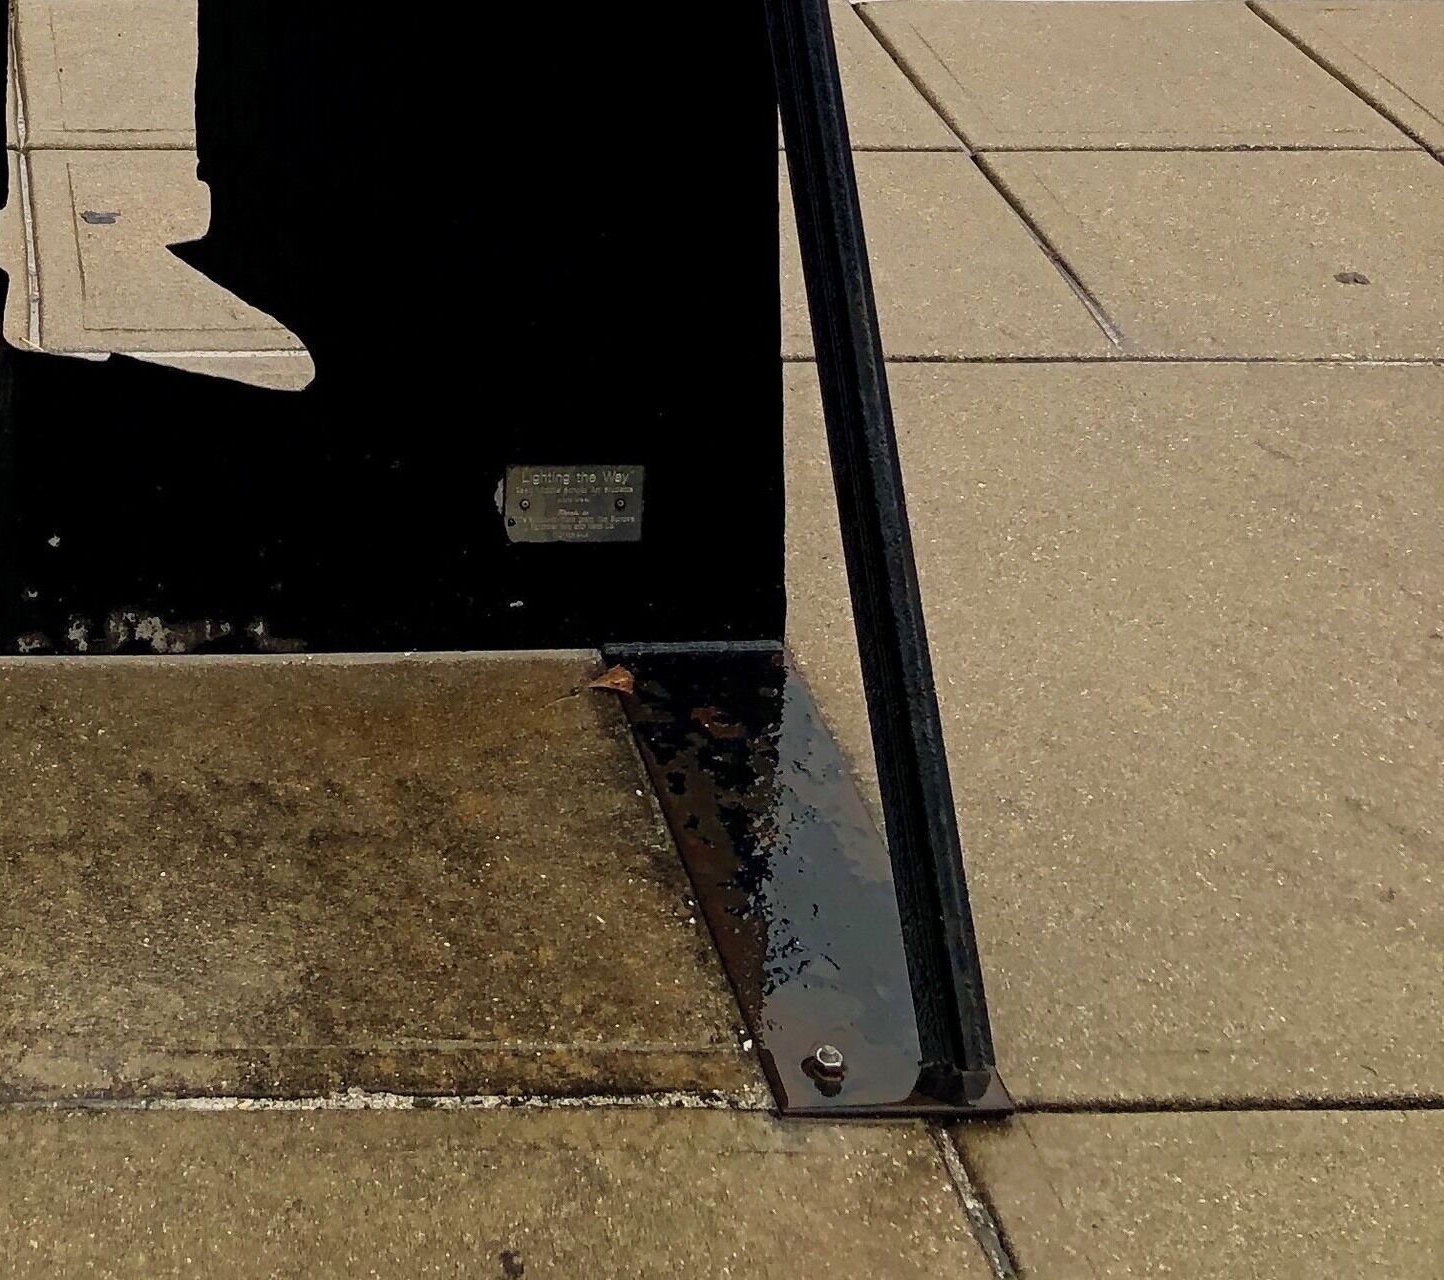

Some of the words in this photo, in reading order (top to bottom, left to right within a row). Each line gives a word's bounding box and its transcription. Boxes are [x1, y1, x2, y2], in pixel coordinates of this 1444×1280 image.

[521, 471, 570, 485] Lighting
[576, 471, 597, 483] the
[602, 470, 629, 485] Way
